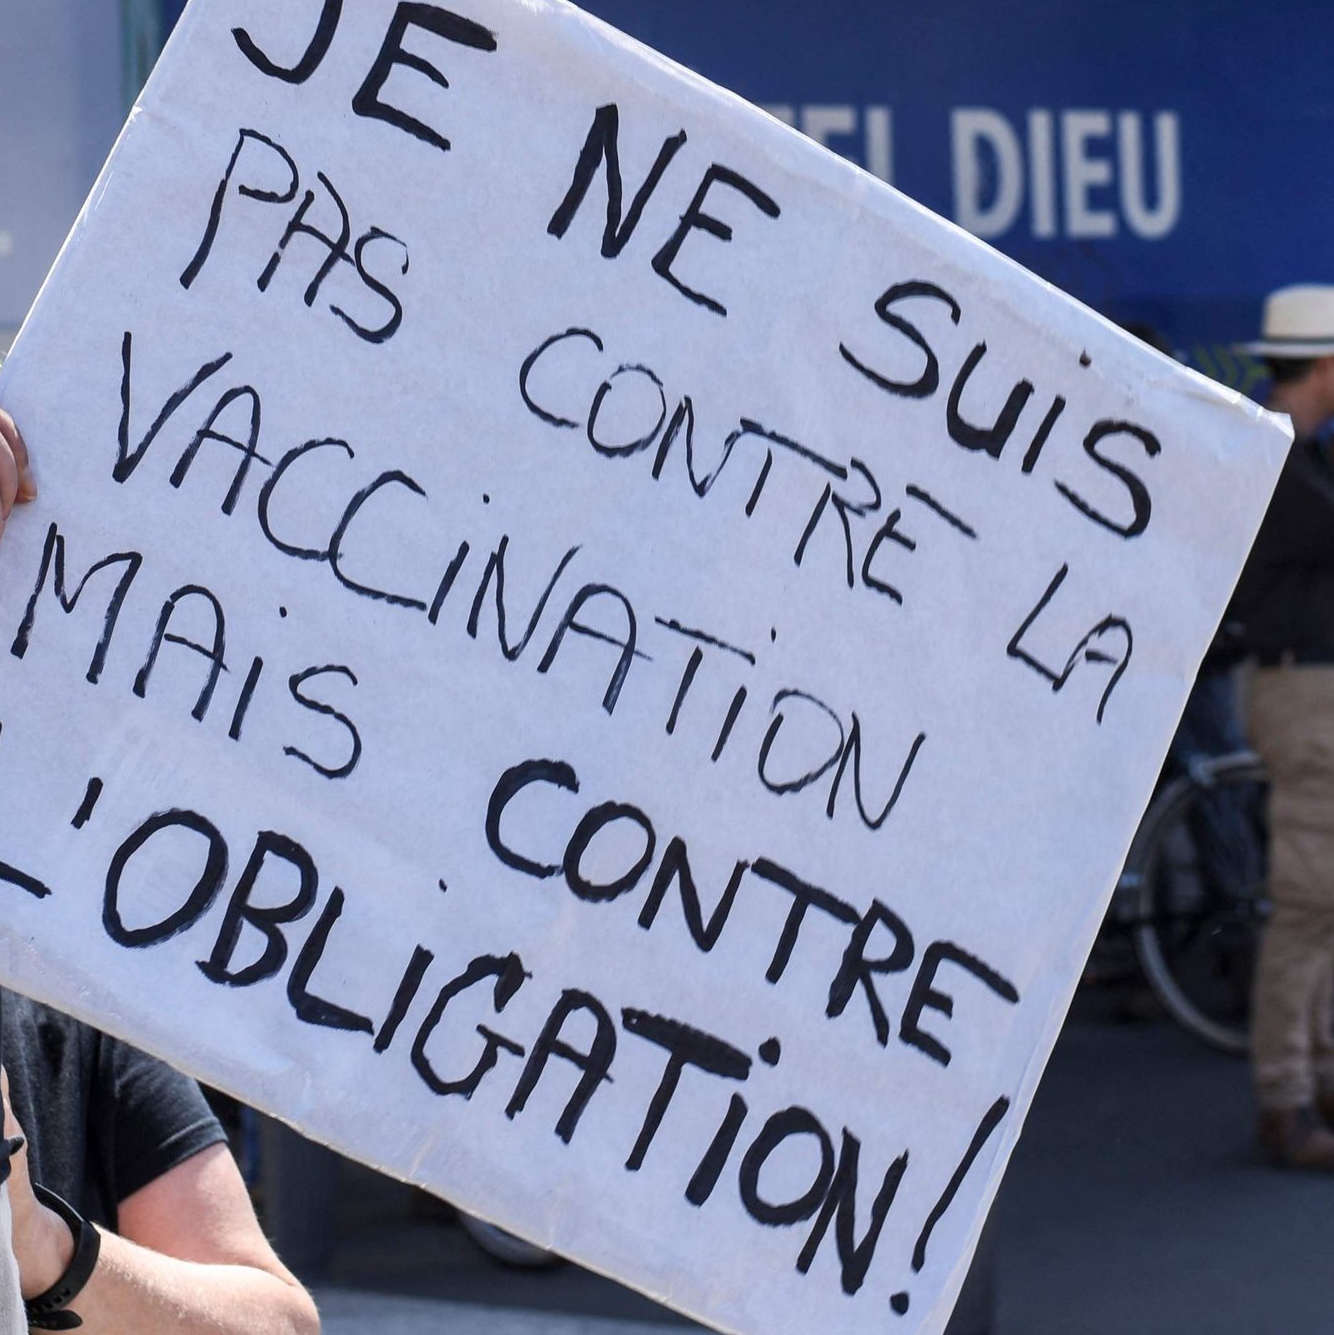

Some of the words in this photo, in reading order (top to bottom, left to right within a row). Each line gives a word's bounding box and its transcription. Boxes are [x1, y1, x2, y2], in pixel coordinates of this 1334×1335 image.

[546, 103, 781, 317] NE
[951, 106, 1181, 239] DIEU
[179, 127, 407, 345] PAS
[519, 327, 979, 607] CONTRE
[1006, 563, 1133, 725] LA
[484, 758, 1020, 1068] CONTRE
